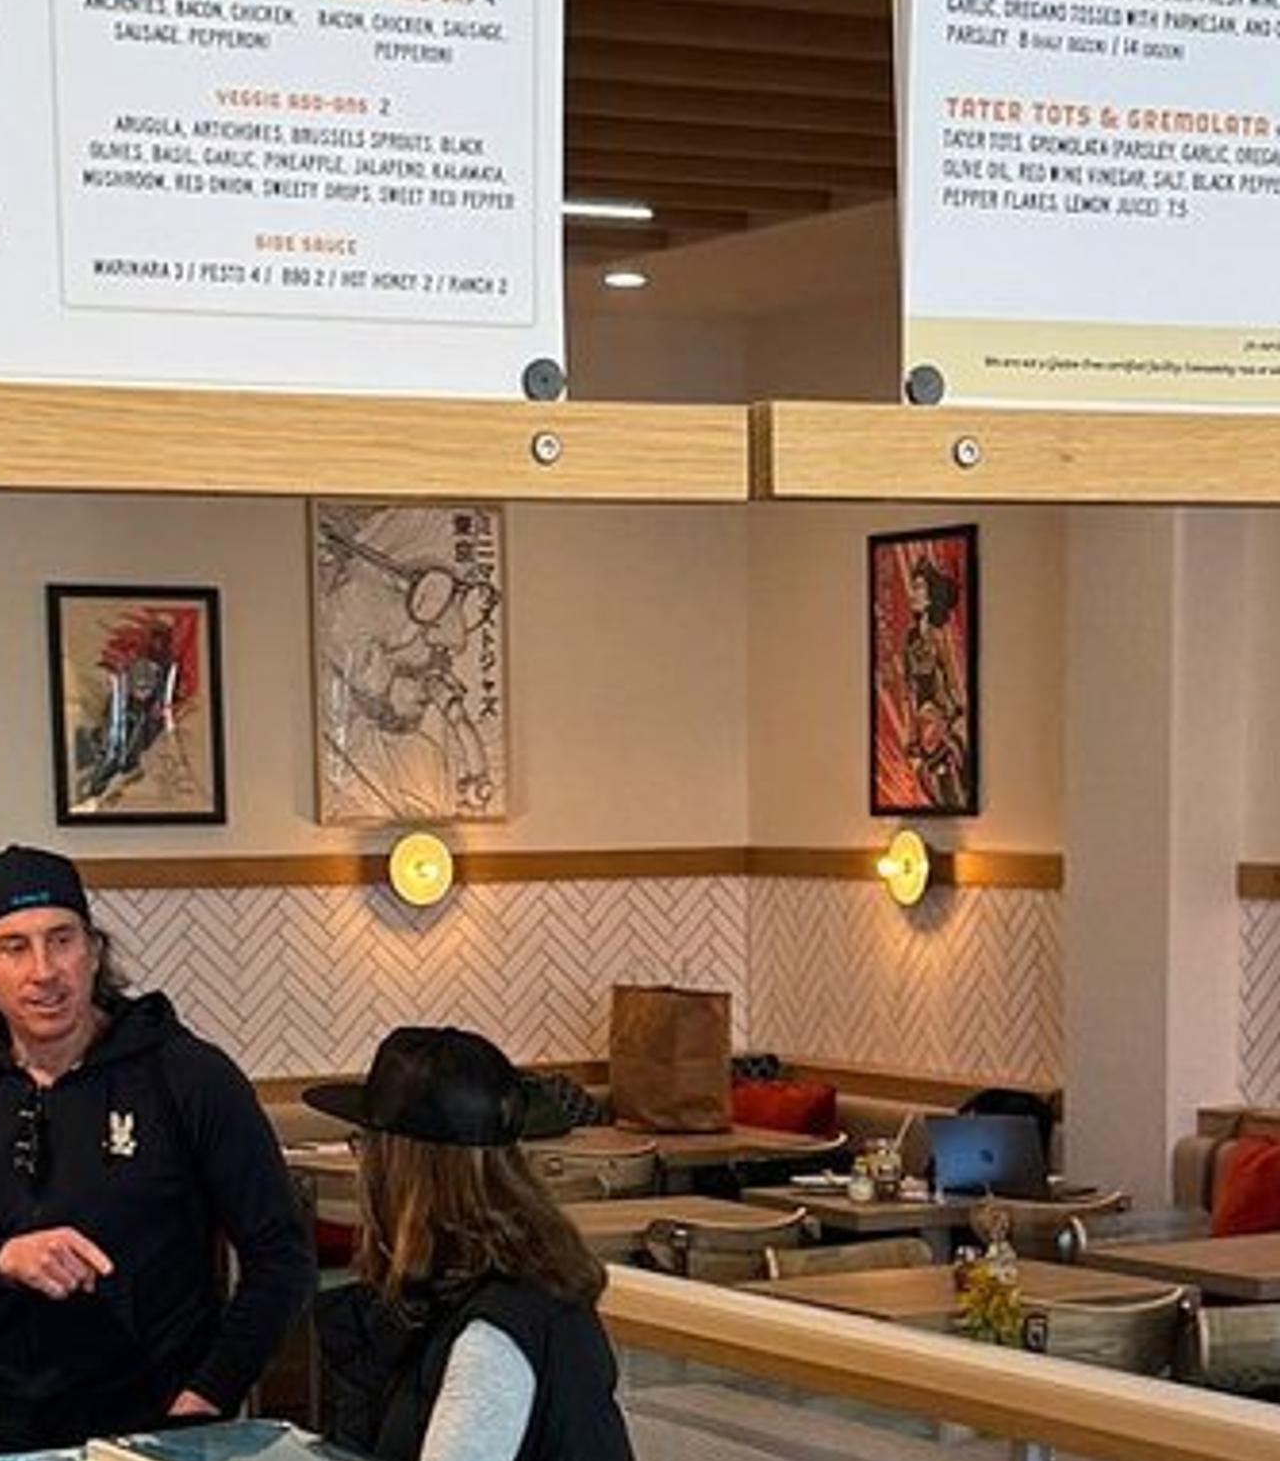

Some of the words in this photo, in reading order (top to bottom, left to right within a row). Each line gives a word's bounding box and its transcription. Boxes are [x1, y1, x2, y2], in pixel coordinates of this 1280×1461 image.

[945, 95, 1023, 123] TATER
[1031, 101, 1092, 128] TOTS
[1099, 105, 1120, 130] &
[1126, 107, 1270, 138] GREMOLATA
